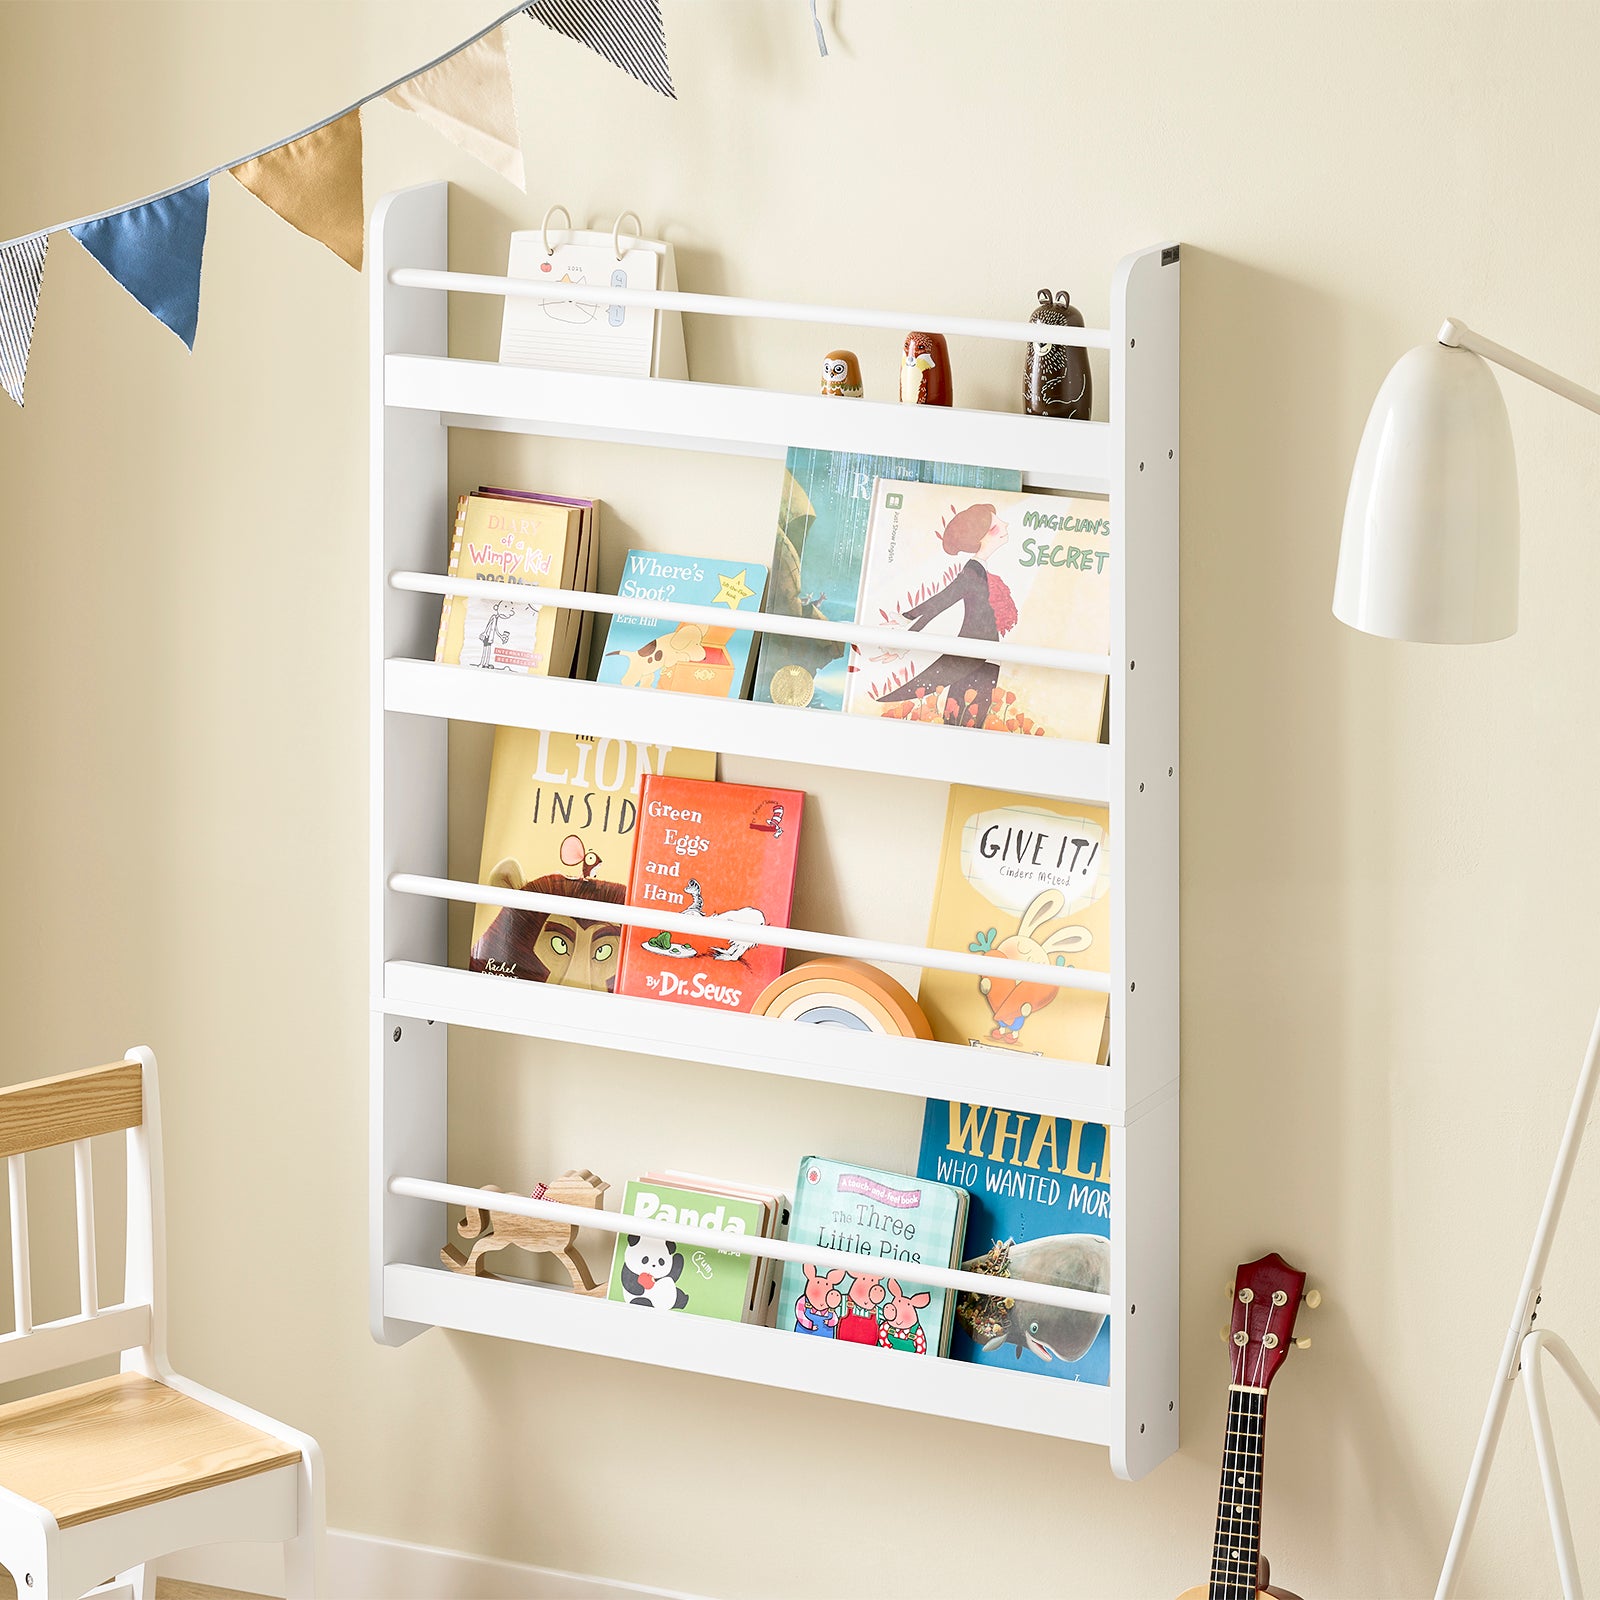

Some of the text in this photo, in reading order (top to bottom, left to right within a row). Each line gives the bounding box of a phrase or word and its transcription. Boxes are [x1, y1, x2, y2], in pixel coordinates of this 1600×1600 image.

[487, 515, 542, 536] DIARY
[1022, 511, 1110, 536] MAGICIAN'S
[501, 534, 525, 550] of a
[468, 543, 552, 575] Wimpy Kid
[630, 555, 705, 582] Where's
[1018, 539, 1110, 574] SECRET
[621, 579, 675, 601] Spot?
[616, 614, 658, 627] Eric Hill
[531, 729, 673, 794] LION
[648, 800, 703, 824] Green
[664, 829, 710, 857] Eggs
[980, 824, 1099, 875] GIVE IT!
[645, 859, 680, 877] and
[1000, 865, 1033, 880] Cinders
[643, 883, 684, 905] Ham
[485, 957, 517, 974] Rachel
[646, 971, 742, 1007] By Dr. Seuss
[841, 1178, 848, 1187] A
[901, 1194, 919, 1205] book
[937, 1155, 1111, 1218] WHO WANTED MOR
[634, 1192, 746, 1235] Panda
[832, 1204, 916, 1240] The Three
[817, 1226, 871, 1256] Little
[694, 1255, 713, 1273] Yum
